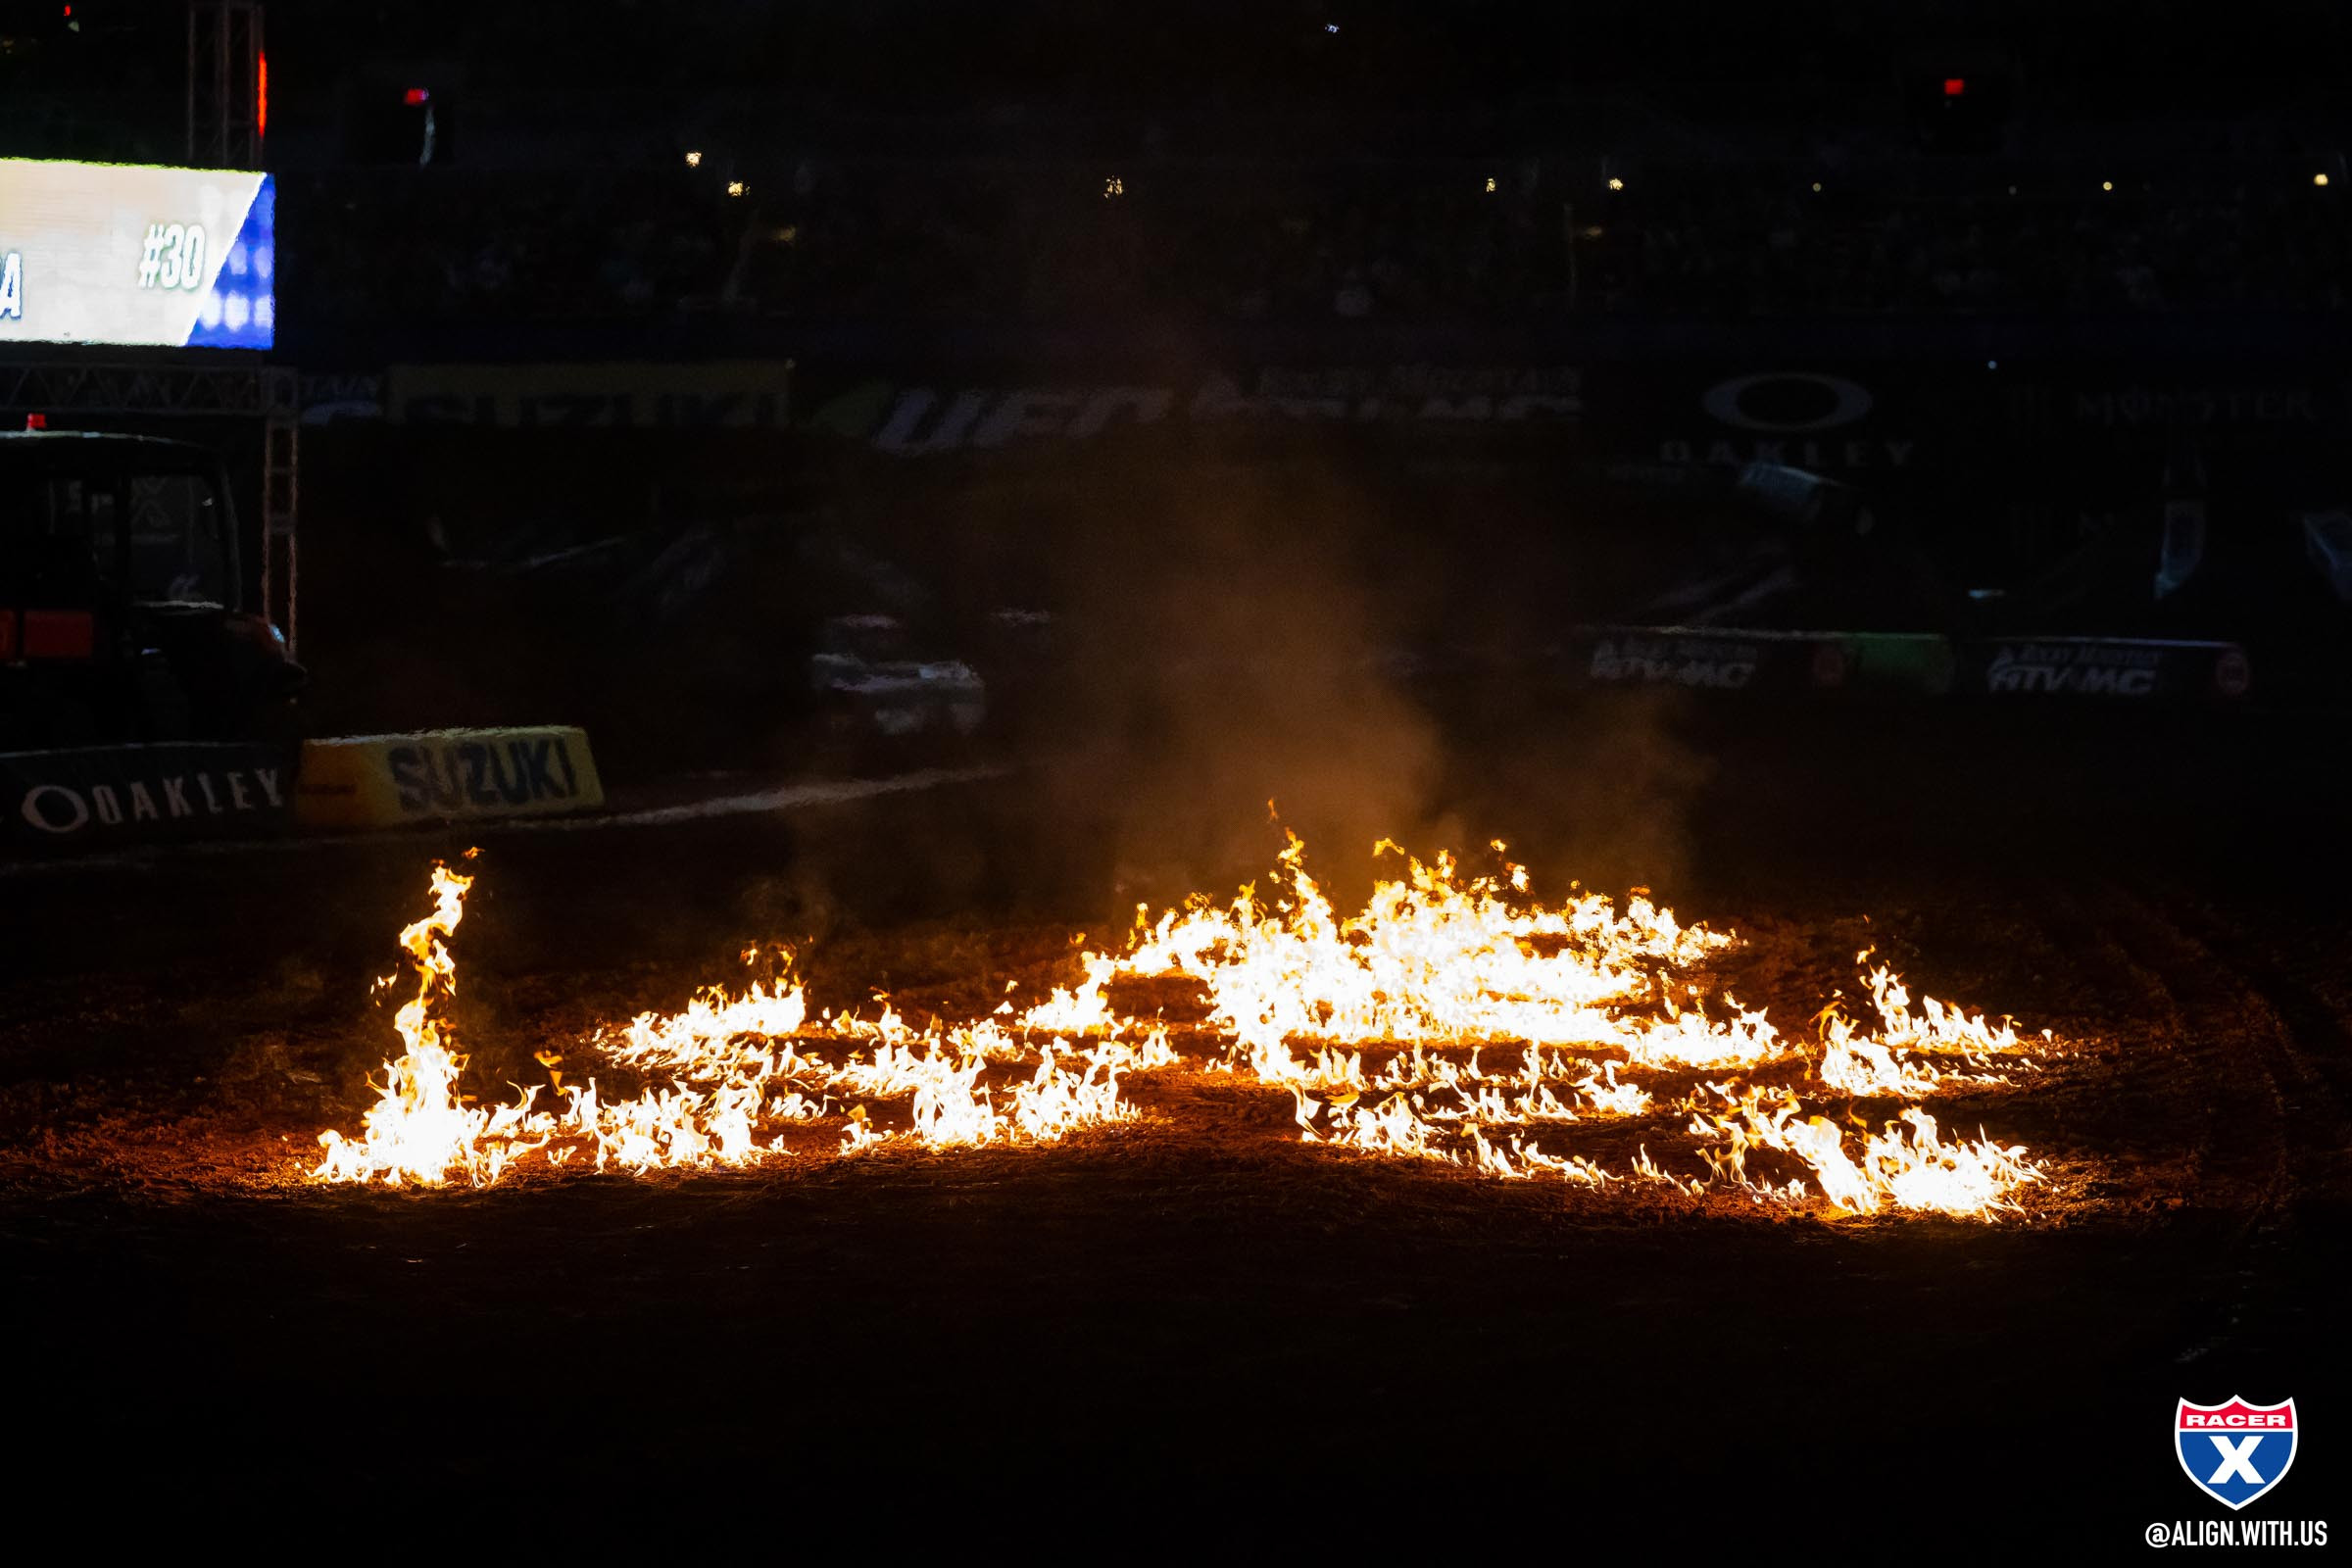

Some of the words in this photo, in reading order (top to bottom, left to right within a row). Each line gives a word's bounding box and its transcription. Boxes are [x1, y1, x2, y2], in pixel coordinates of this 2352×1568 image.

[138, 223, 206, 290] #30
[1659, 439, 1914, 468] OAKLEY
[91, 766, 285, 825] OAKLEY
[387, 737, 578, 812] SUZUKI
